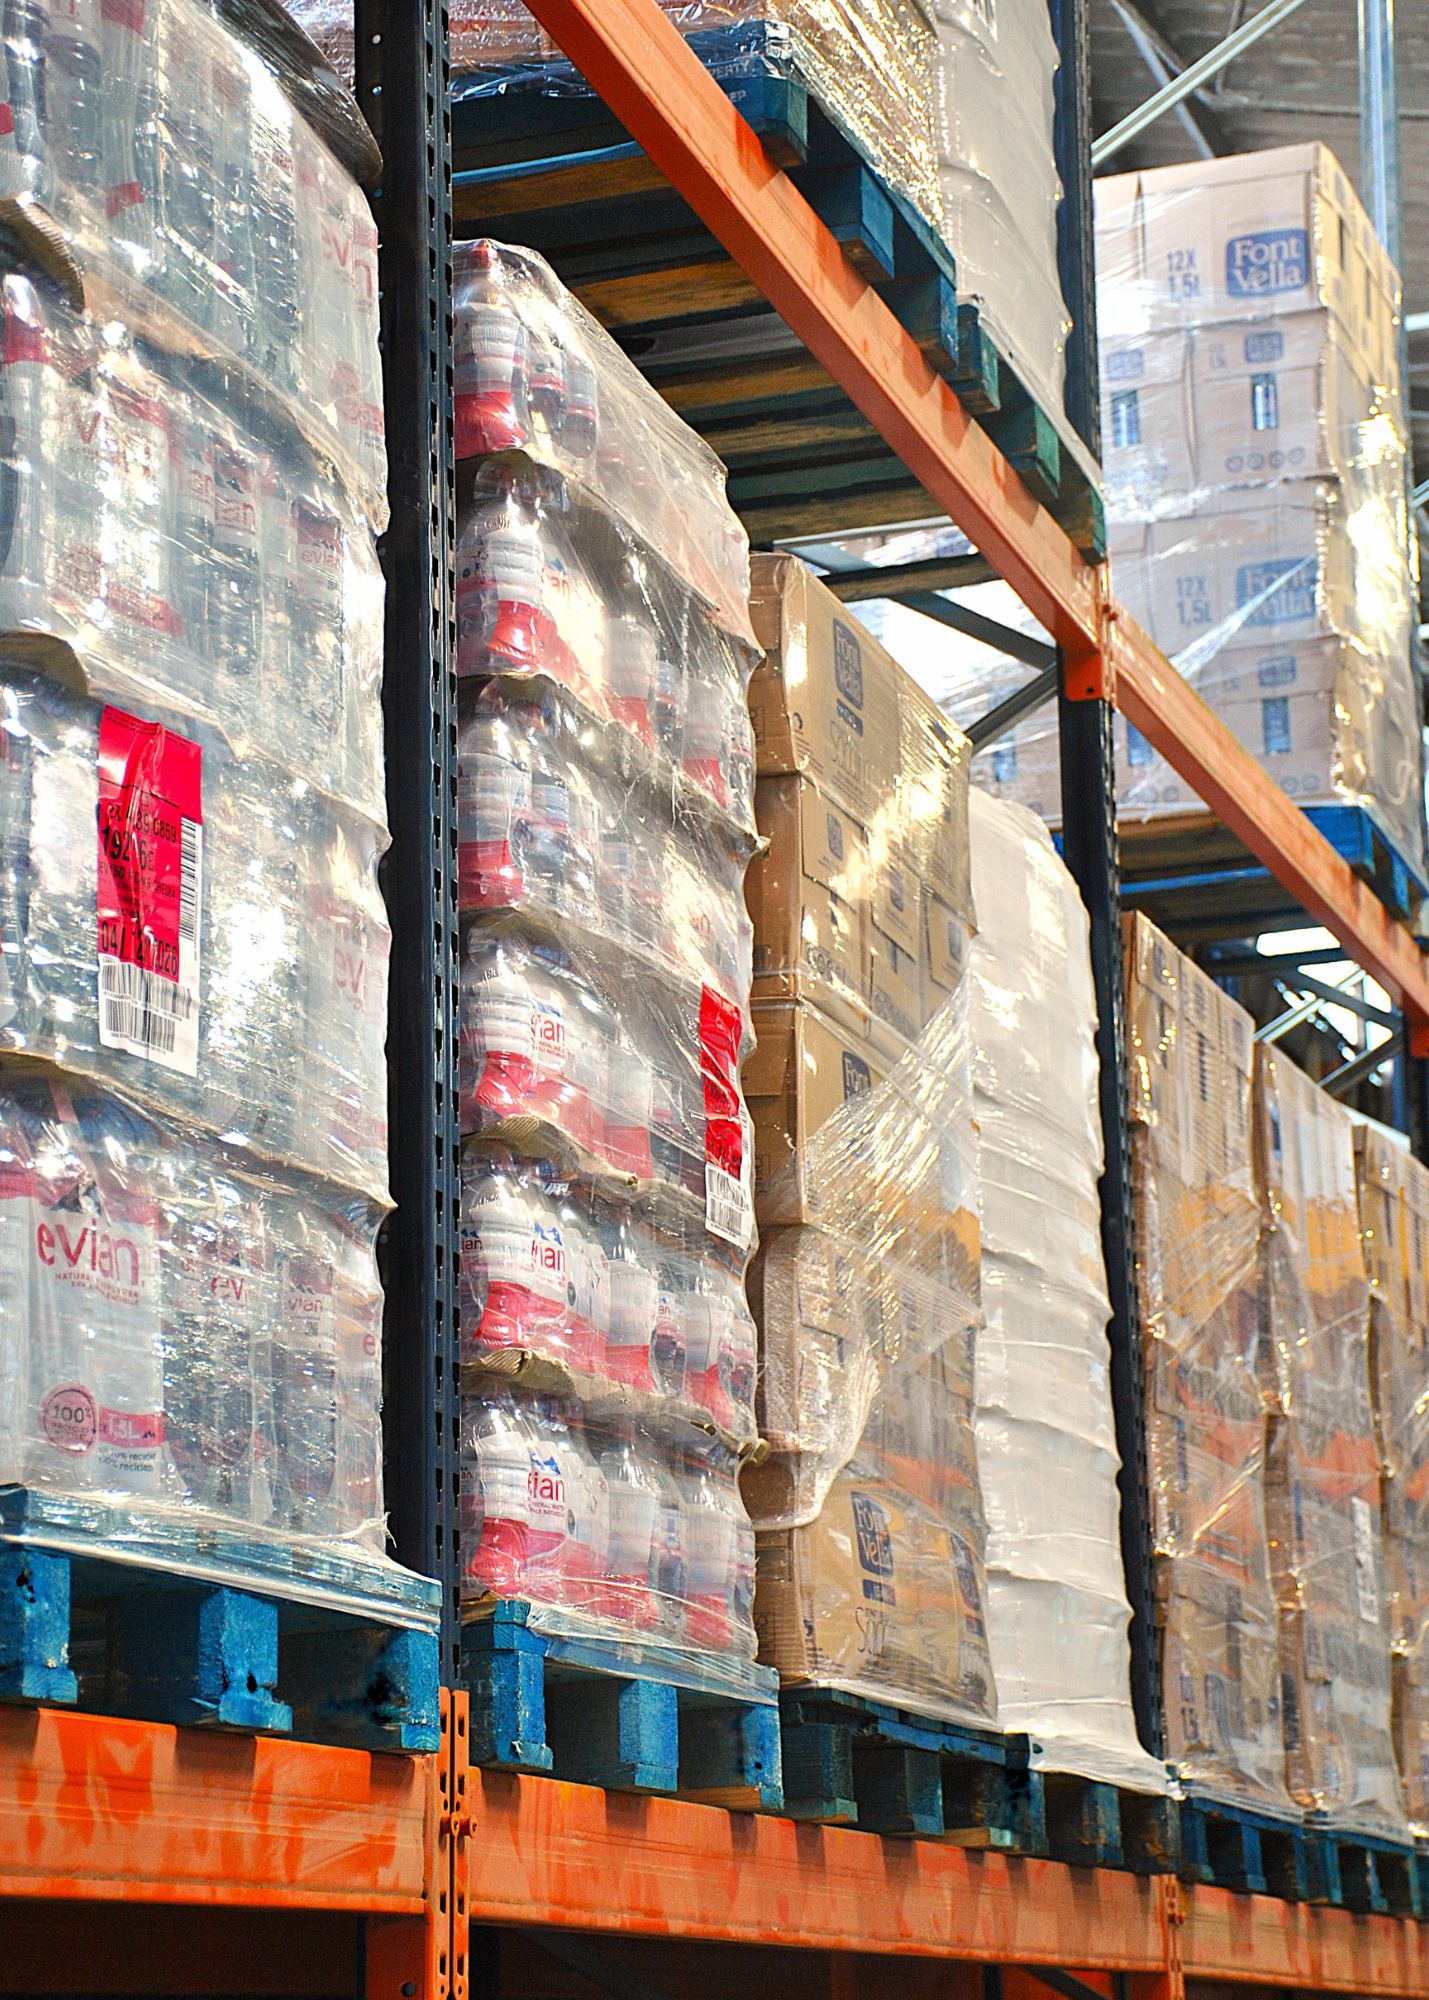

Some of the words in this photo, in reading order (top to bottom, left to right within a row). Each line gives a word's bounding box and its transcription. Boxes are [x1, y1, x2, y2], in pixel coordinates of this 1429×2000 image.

[1234, 236, 1301, 266] Font
[1232, 262, 1301, 294] Vella
[36, 1217, 139, 1287] evian
